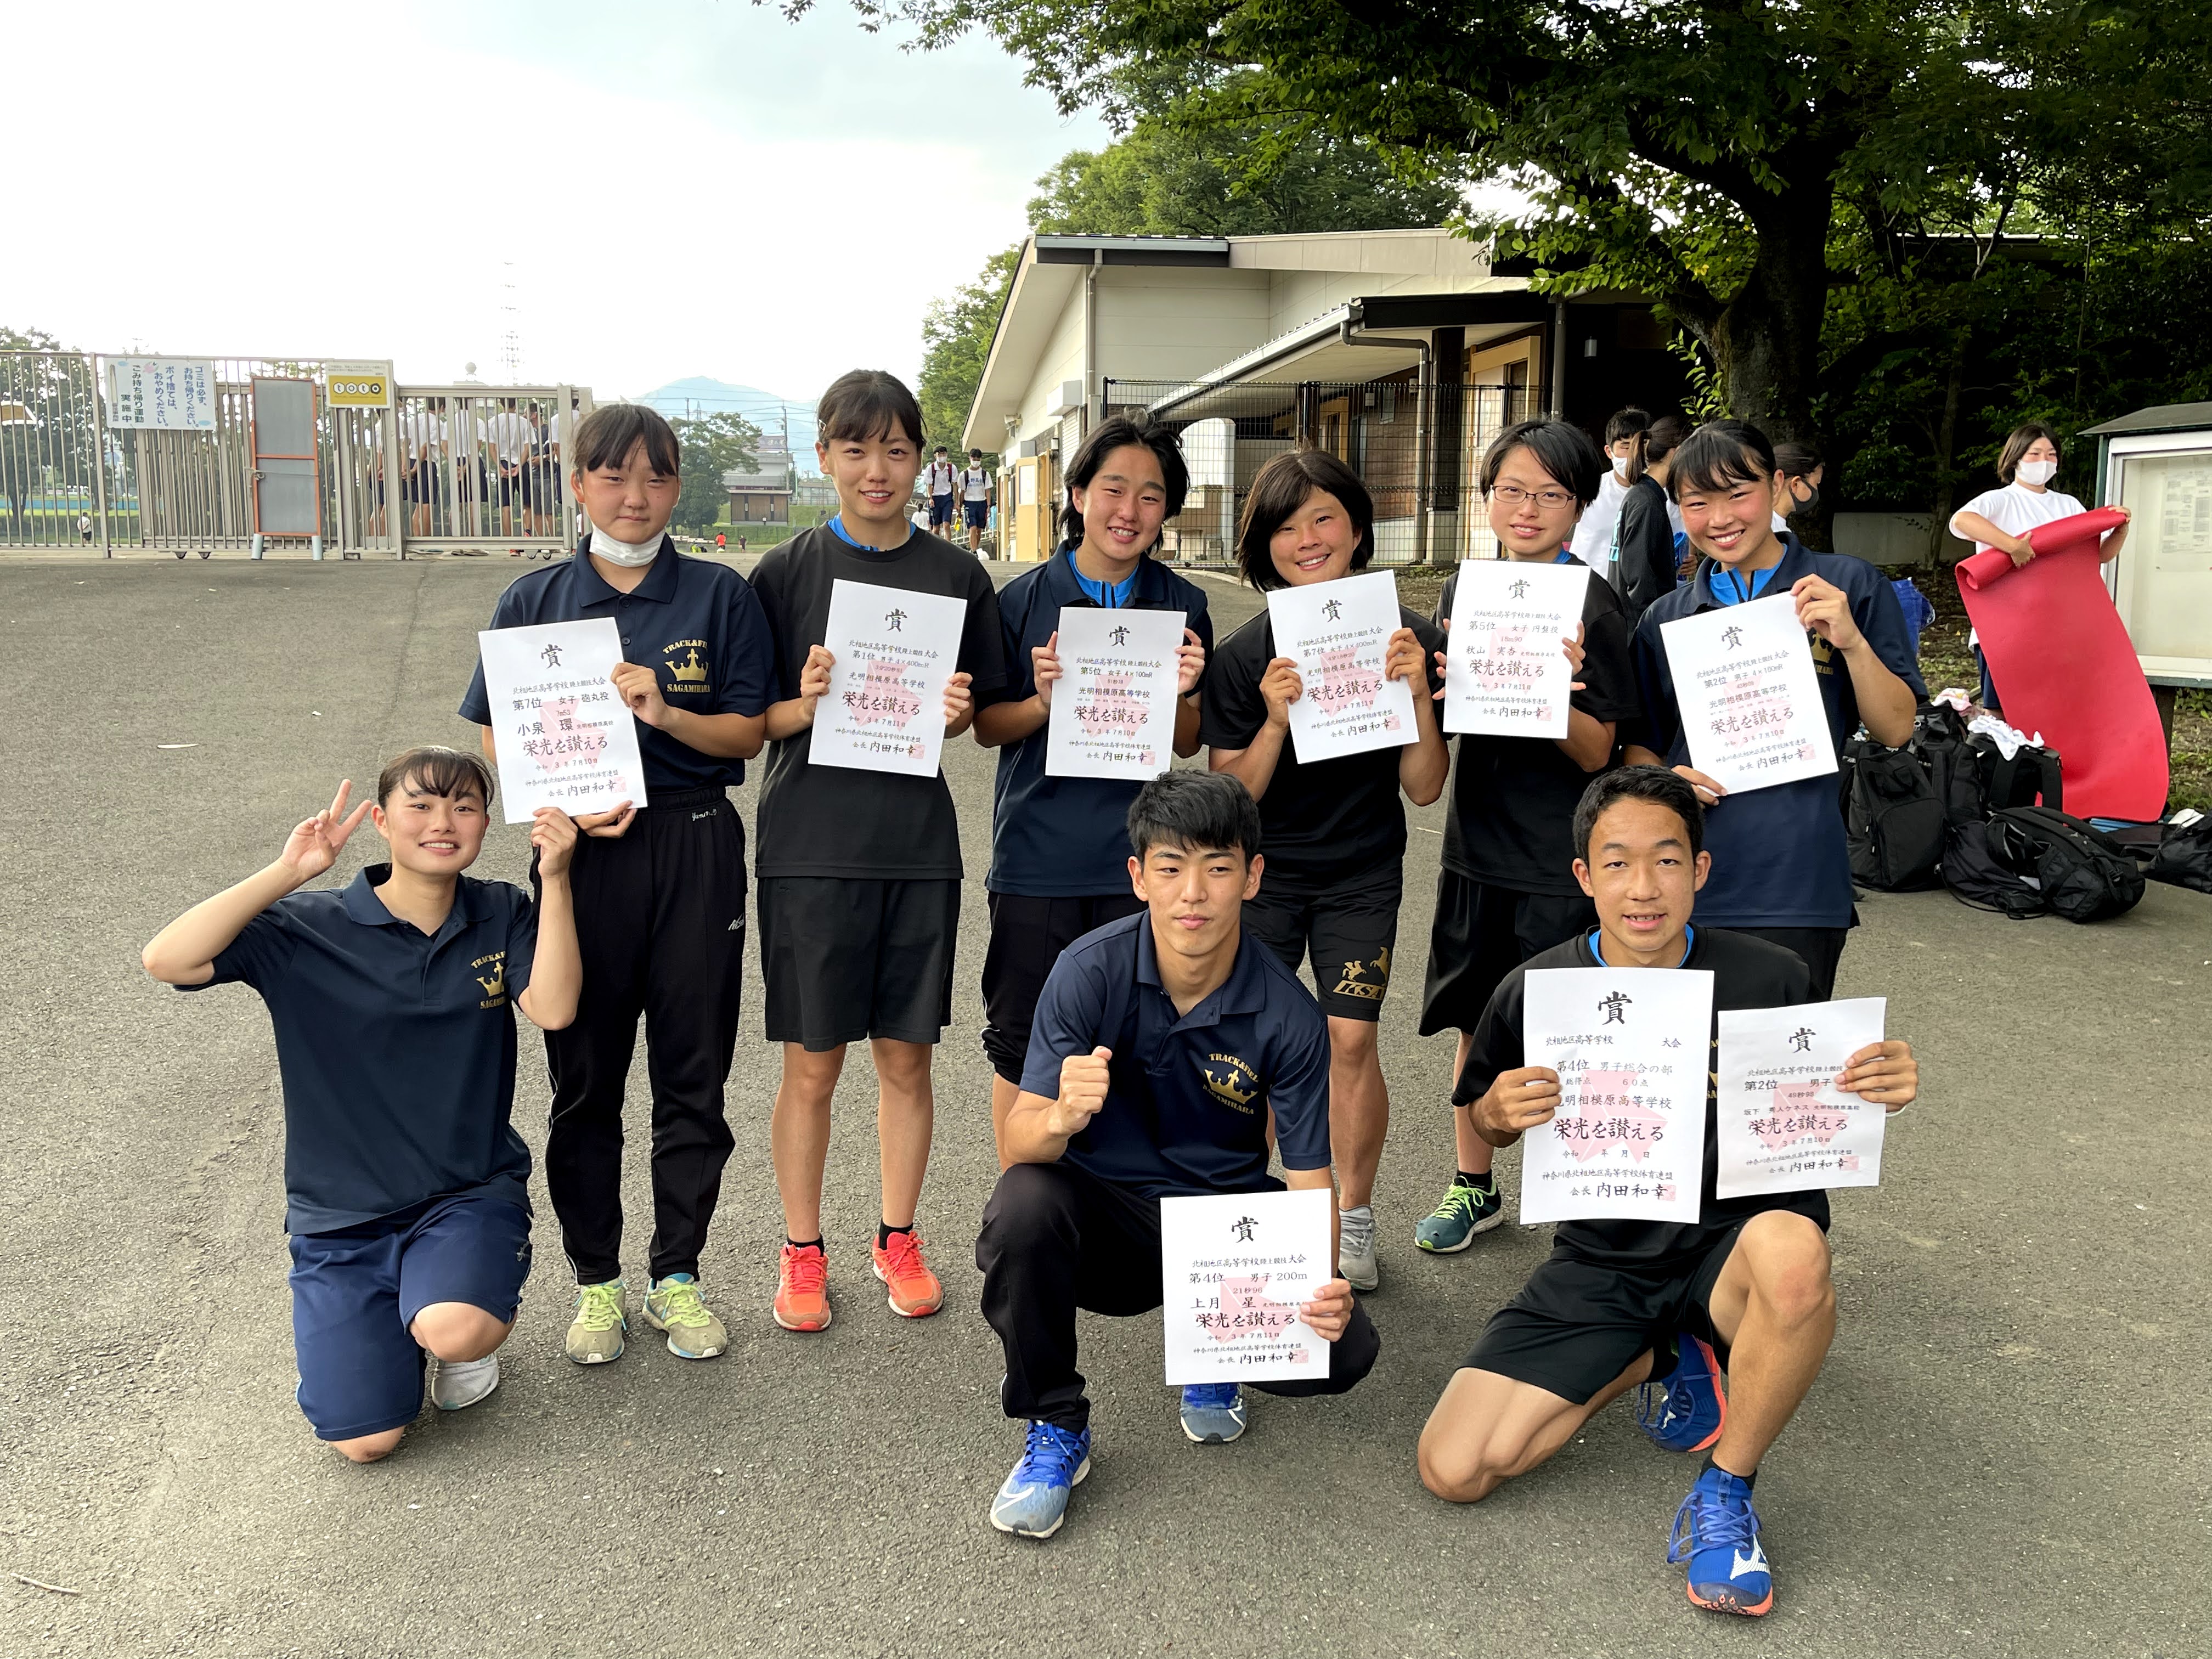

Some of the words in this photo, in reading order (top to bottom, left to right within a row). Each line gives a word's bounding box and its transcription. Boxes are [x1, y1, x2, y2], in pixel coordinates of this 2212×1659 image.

[166, 366, 177, 410] ポイ捨ては、
[195, 366, 207, 406] ゴミは必ず、
[154, 373, 168, 426] おやめください。
[184, 367, 199, 427] お持ち帰りください。
[121, 394, 132, 422] 実施中
[1509, 579, 1531, 599] 賞
[1322, 599, 1342, 622] 賞
[884, 608, 907, 632] 賞
[1468, 621, 1496, 630] 第5位
[1532, 625, 1559, 633] 円盤投
[1109, 625, 1130, 646] 賞
[1721, 626, 1743, 651] 賞
[541, 644, 563, 669] 賞
[852, 650, 875, 660] 第1位
[1304, 647, 1325, 658] 第7位
[1466, 646, 1485, 654] 秋山
[1080, 667, 1101, 675] 第5位
[1307, 658, 1380, 677] 光明相模原高等学校
[1470, 659, 1544, 677] 栄光を讃える
[849, 672, 926, 689] 光明相模原高等学校
[1705, 676, 1727, 689] 第2位
[1734, 672, 1748, 682] 男子
[1079, 687, 1150, 698] 光明相模原高等学校
[1307, 679, 1383, 703] 栄光を讃える
[1709, 684, 1787, 708] 光明相模原高等学校
[512, 698, 542, 711] 第7位
[558, 696, 576, 704] 女子
[581, 691, 609, 703] 砲丸投
[842, 691, 920, 715] 栄光を讃える
[1074, 706, 1148, 724] 栄光を讃える
[1499, 707, 1544, 718] 内田和幸
[1710, 707, 1793, 735] 栄光を讃える
[518, 721, 545, 736] 小泉
[560, 718, 574, 732] 環
[1330, 729, 1344, 737] 会長
[1347, 719, 1392, 736] 内田和幸
[523, 736, 607, 757] 栄光を讃える
[870, 741, 917, 756] 内田和幸
[1103, 751, 1148, 763] 内田和幸
[1739, 763, 1753, 771] 会長
[1757, 748, 1806, 769] 内田和幸
[548, 788, 564, 797] 会長
[567, 780, 617, 796] 内田和幸
[1598, 991, 1633, 1025] 賞
[1546, 1035, 1613, 1046] 北相地区高等学校
[1662, 1038, 1681, 1048] 大会
[1788, 1028, 1816, 1053] 賞
[1557, 1059, 1590, 1074] 第4位
[1600, 1062, 1673, 1076] 男子総合の部
[1566, 1077, 1591, 1086] 総得点
[1623, 1079, 1649, 1087] 60点
[1744, 1079, 1778, 1091] 第2位
[1810, 1079, 1832, 1087] 男子
[1203, 1084, 1254, 1114] SAGAMIHARA
[1558, 1094, 1672, 1110] 明相模原高等学校
[1554, 1118, 1663, 1141] 栄光を讃える
[1748, 1114, 1848, 1136] 栄光を讃える
[1562, 1150, 1578, 1158] 令和
[1621, 1150, 1628, 1158] 月
[1542, 1169, 1673, 1180] 神奈川県北相地区高等学校体育連盟
[1790, 1159, 1848, 1173] 内田和幸
[1569, 1187, 1591, 1196] 会長
[1596, 1183, 1668, 1199] 内田和幸
[1231, 1216, 1259, 1243] 賞
[1189, 1273, 1225, 1284] 第4位
[1251, 1273, 1272, 1282] 男子
[1277, 1272, 1307, 1281] 200m
[1190, 1297, 1219, 1309] 上月
[1242, 1297, 1256, 1308] 星
[1195, 1312, 1295, 1328] 栄光を讃える
[1240, 1351, 1299, 1364] 内田和幸
